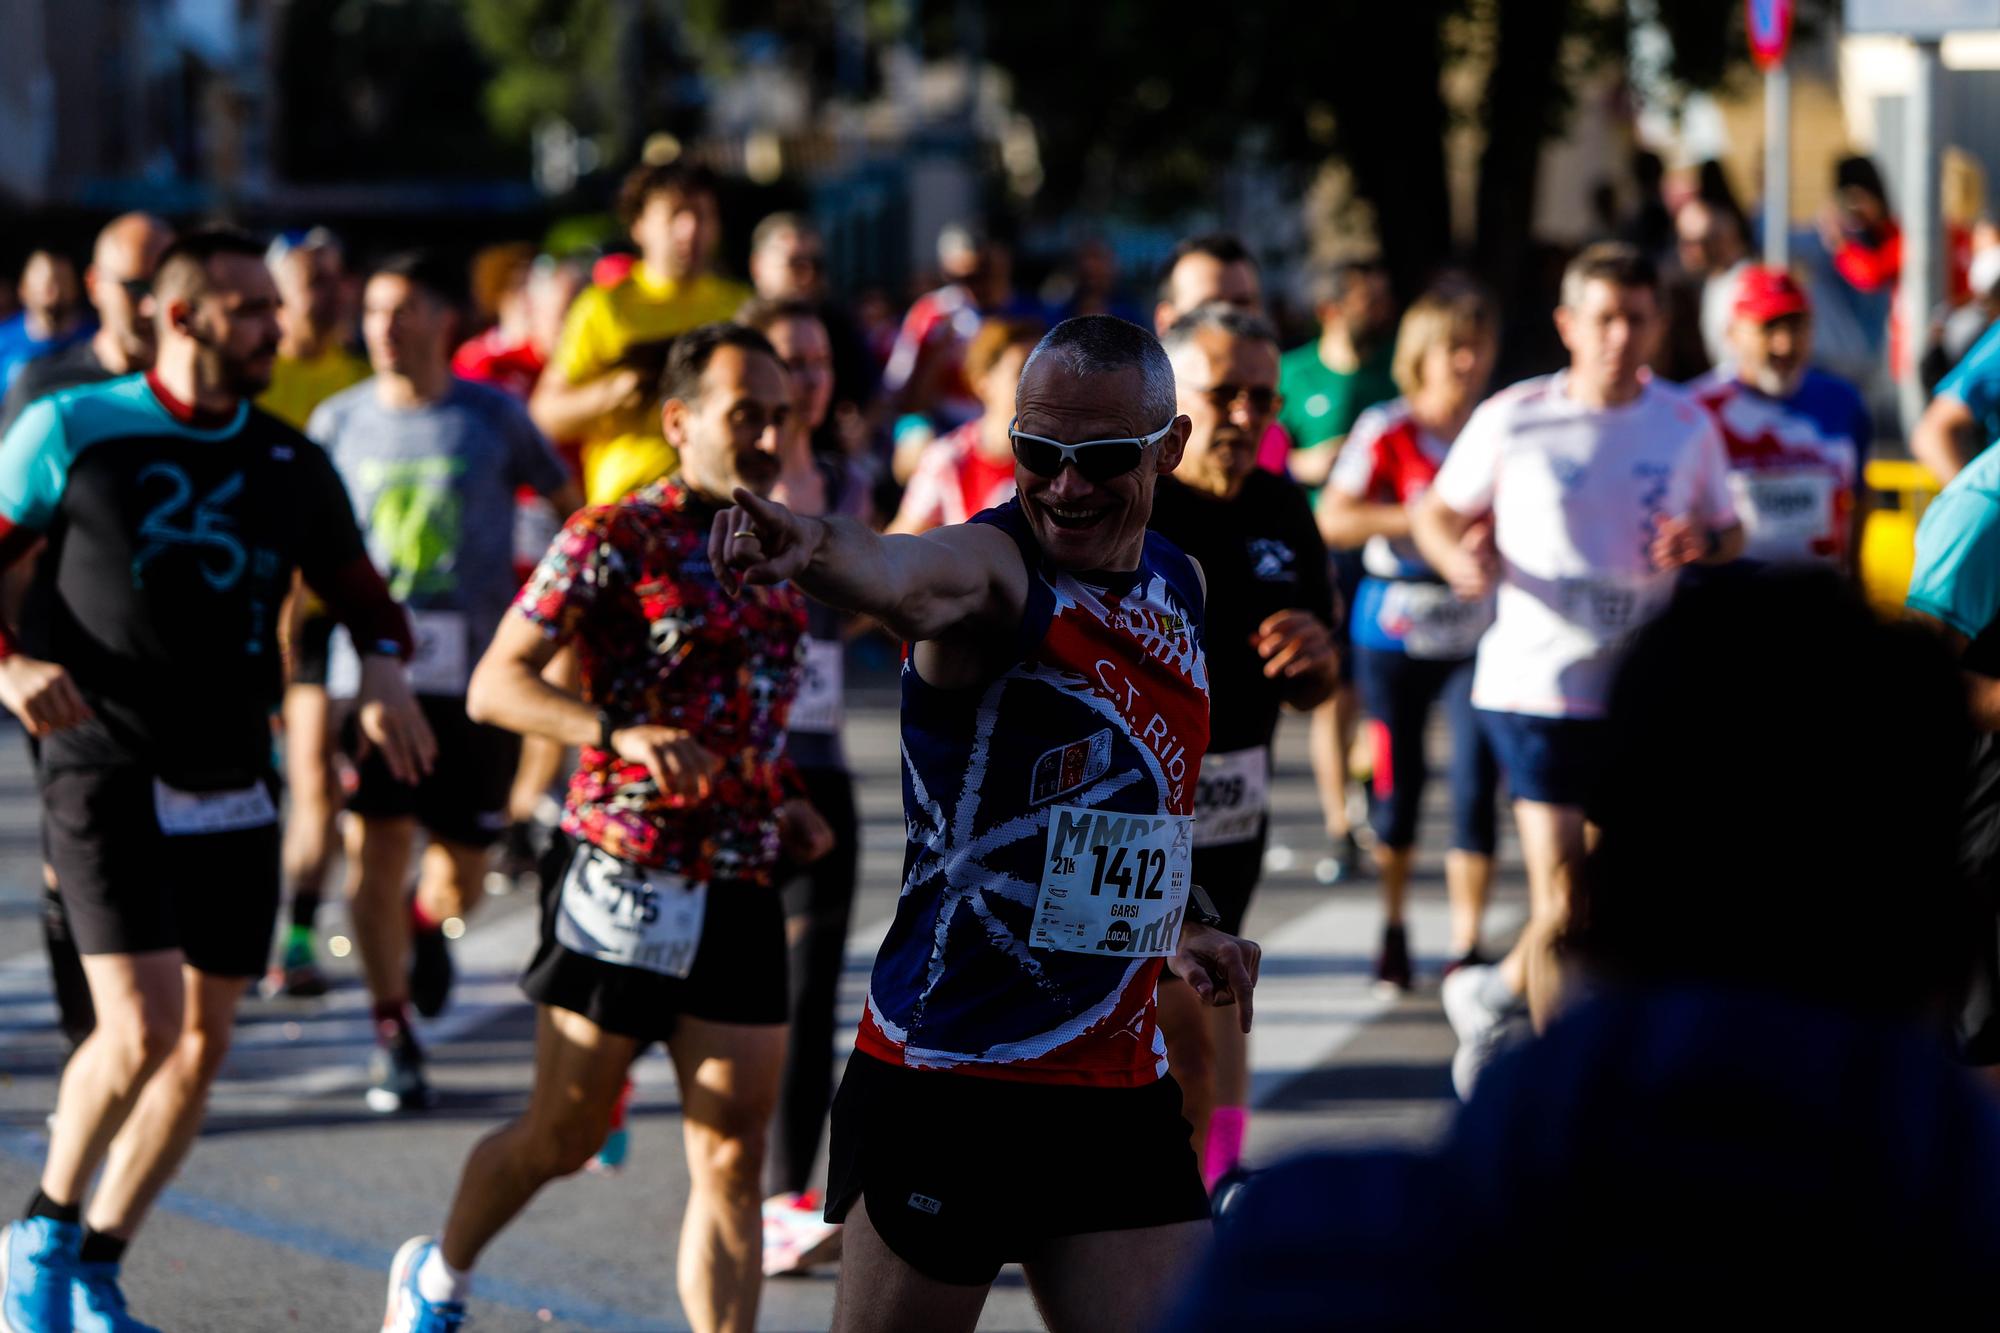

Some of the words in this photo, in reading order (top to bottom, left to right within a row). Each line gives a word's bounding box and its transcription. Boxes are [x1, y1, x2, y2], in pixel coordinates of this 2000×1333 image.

[1090, 845, 1166, 900] 1412
[1110, 903, 1140, 918] GARSI
[1107, 930, 1130, 943] LOCAL
